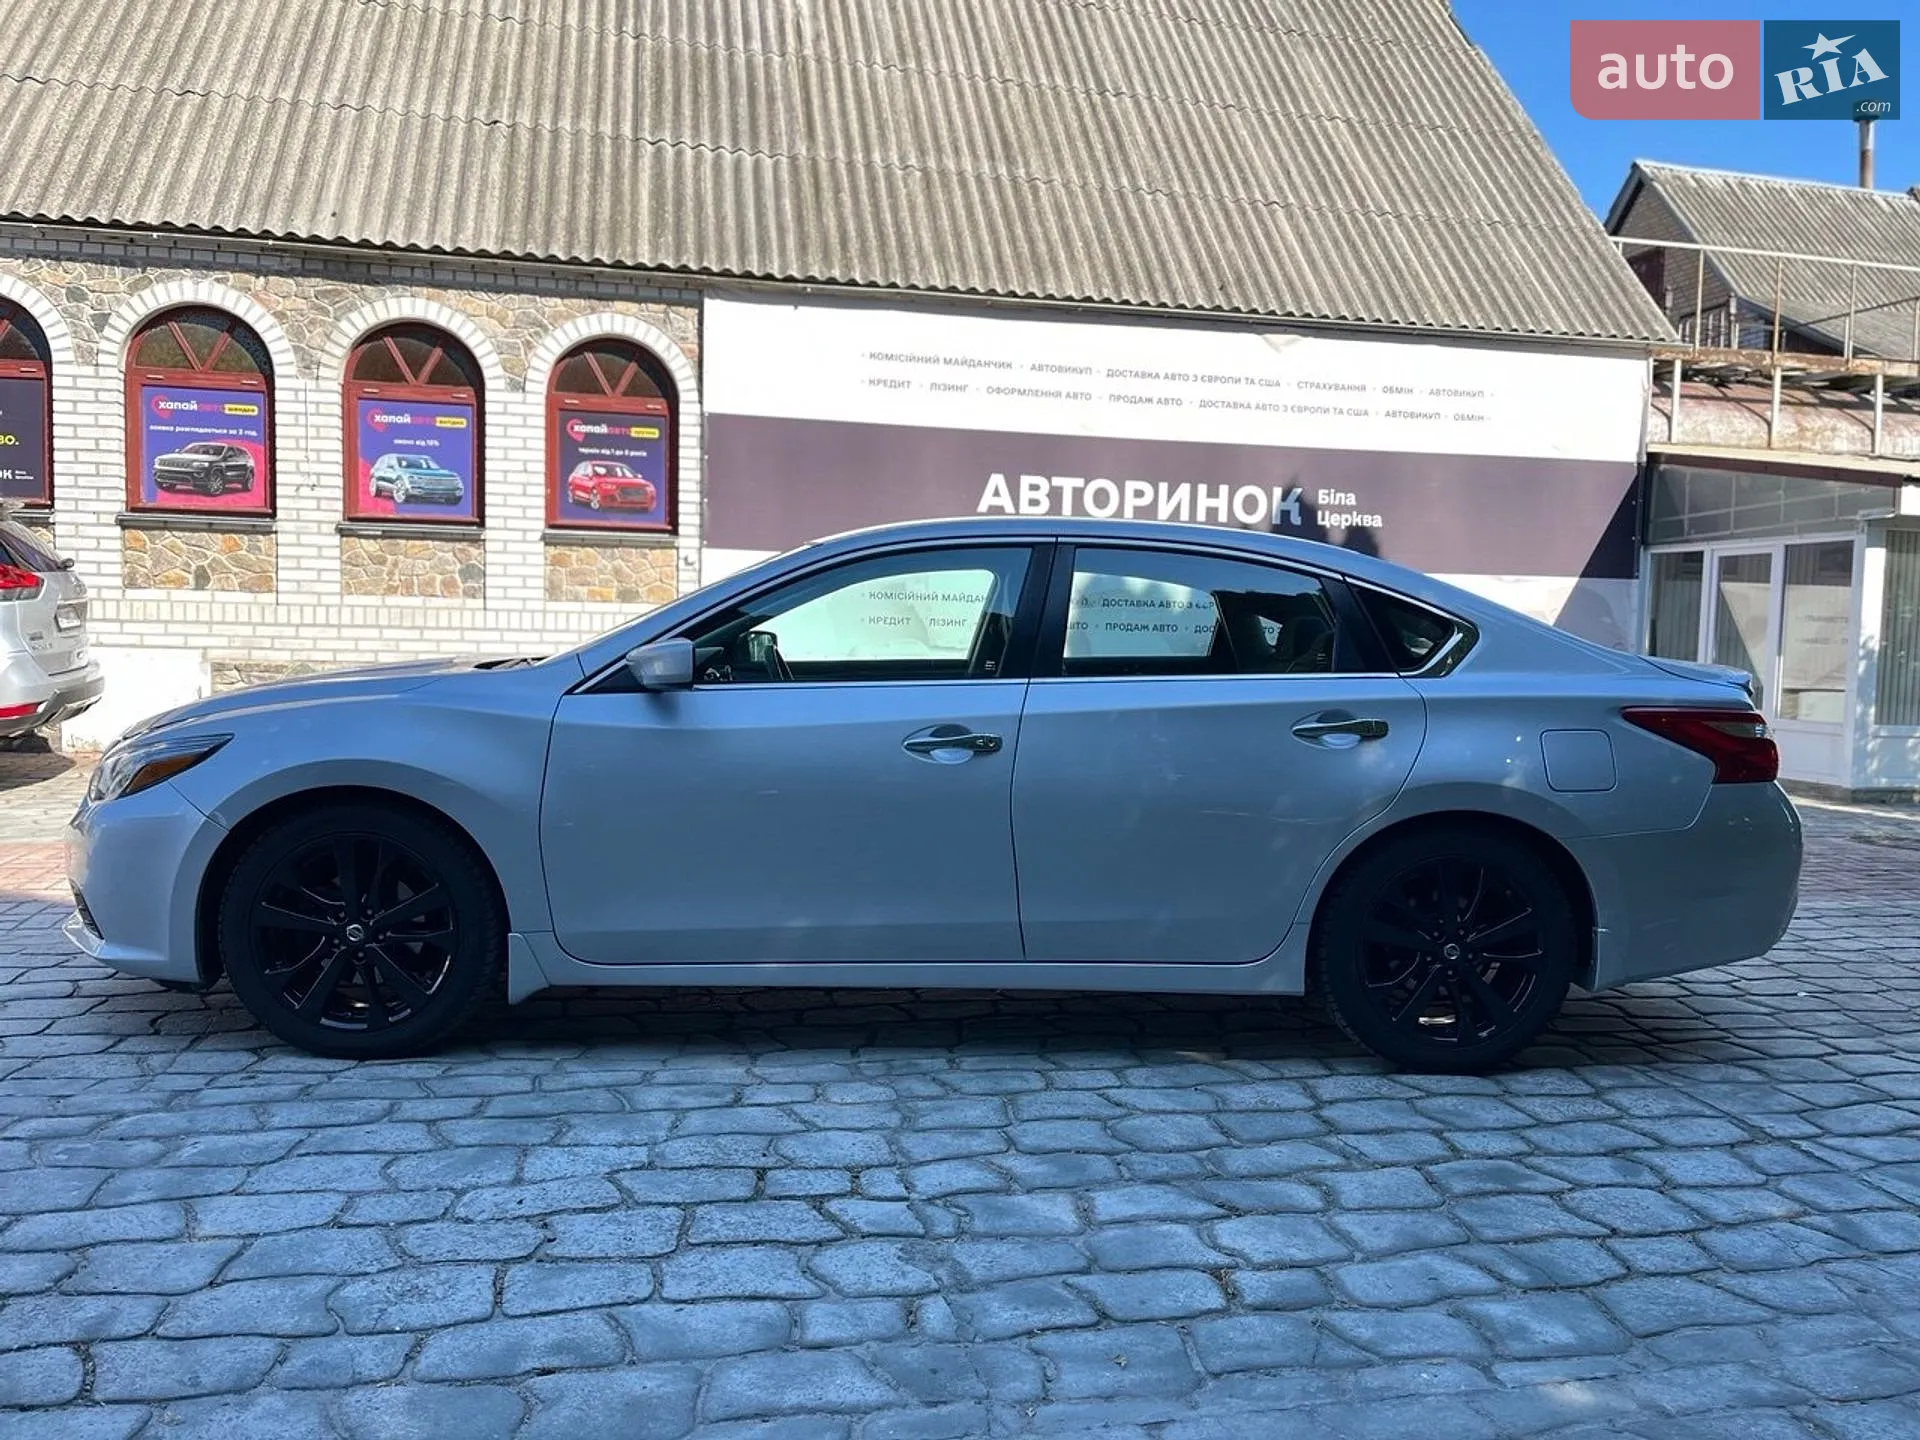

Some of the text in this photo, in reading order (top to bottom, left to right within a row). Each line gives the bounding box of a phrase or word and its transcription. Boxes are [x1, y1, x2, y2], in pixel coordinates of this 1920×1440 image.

[869, 351, 940, 365] КОМІСІЙНИЙ
[943, 355, 1013, 369] МАЙДАНЧИК
[1030, 363, 1092, 376] АВТОВИКУП
[1106, 368, 1160, 380] ДОСТАВКА
[1163, 373, 1189, 382] АВТО
[1245, 376, 1256, 386] ТА
[1258, 378, 1281, 387] США
[1297, 380, 1366, 393] СТРАХУВАННЯ
[1428, 388, 1484, 398] АВТОВИКУП
[868, 377, 911, 389] КРЕДИТ
[930, 382, 968, 393] ЛІЗИНГ
[986, 385, 1062, 399] ОФОРМЛЕННЯ
[1065, 391, 1092, 401] АВТО
[1109, 393, 1153, 405] ПРОДАЖ
[1157, 397, 1183, 407] АВТО
[1199, 399, 1252, 410] ДОСТАВКА
[1255, 403, 1281, 413] АВТО
[1333, 407, 1345, 416] ТА
[1346, 408, 1369, 417] США
[977, 473, 1303, 526] АВТОРИНОК
[1317, 488, 1357, 506] Біла
[1317, 510, 1383, 529] Церква
[868, 616, 912, 626] КРЕДИТ
[1105, 623, 1149, 634] ПРОДАЖ
[1151, 623, 1178, 633] АВТО
